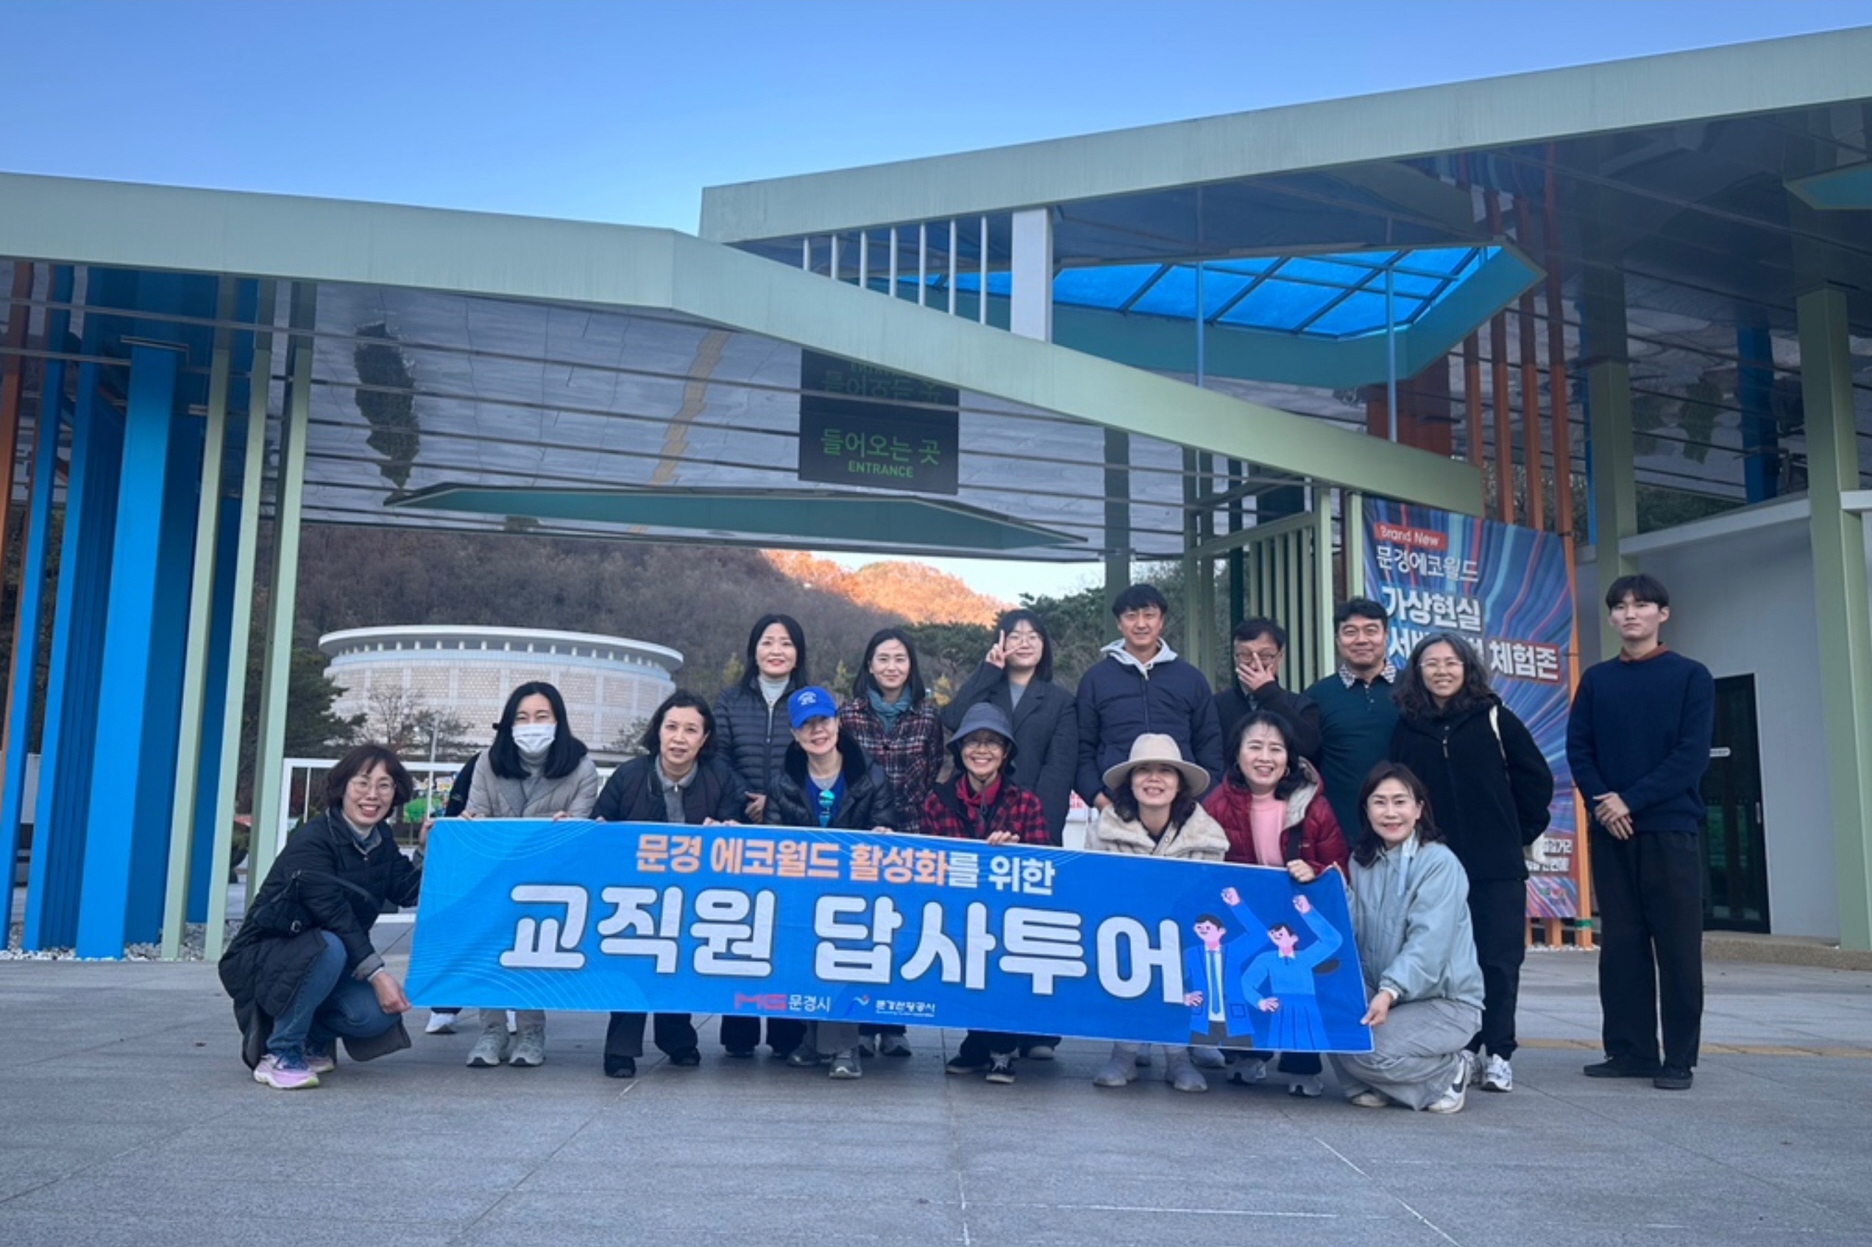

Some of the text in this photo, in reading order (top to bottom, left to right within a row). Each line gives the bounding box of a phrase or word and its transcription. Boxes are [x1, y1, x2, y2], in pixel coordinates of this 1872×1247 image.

[821, 429, 941, 465] 들어오는 곳
[848, 460, 914, 478] ENTRANCE
[1380, 524, 1440, 546] Brand New
[1376, 545, 1479, 582] 문경에코월드
[1381, 586, 1482, 632] 가상현실
[1489, 640, 1558, 681] 체험존
[636, 834, 1055, 896] 문경 에코월드 활성화를 위한
[499, 884, 1185, 1004] 교직원 답사투어
[789, 994, 831, 1012] 문경시
